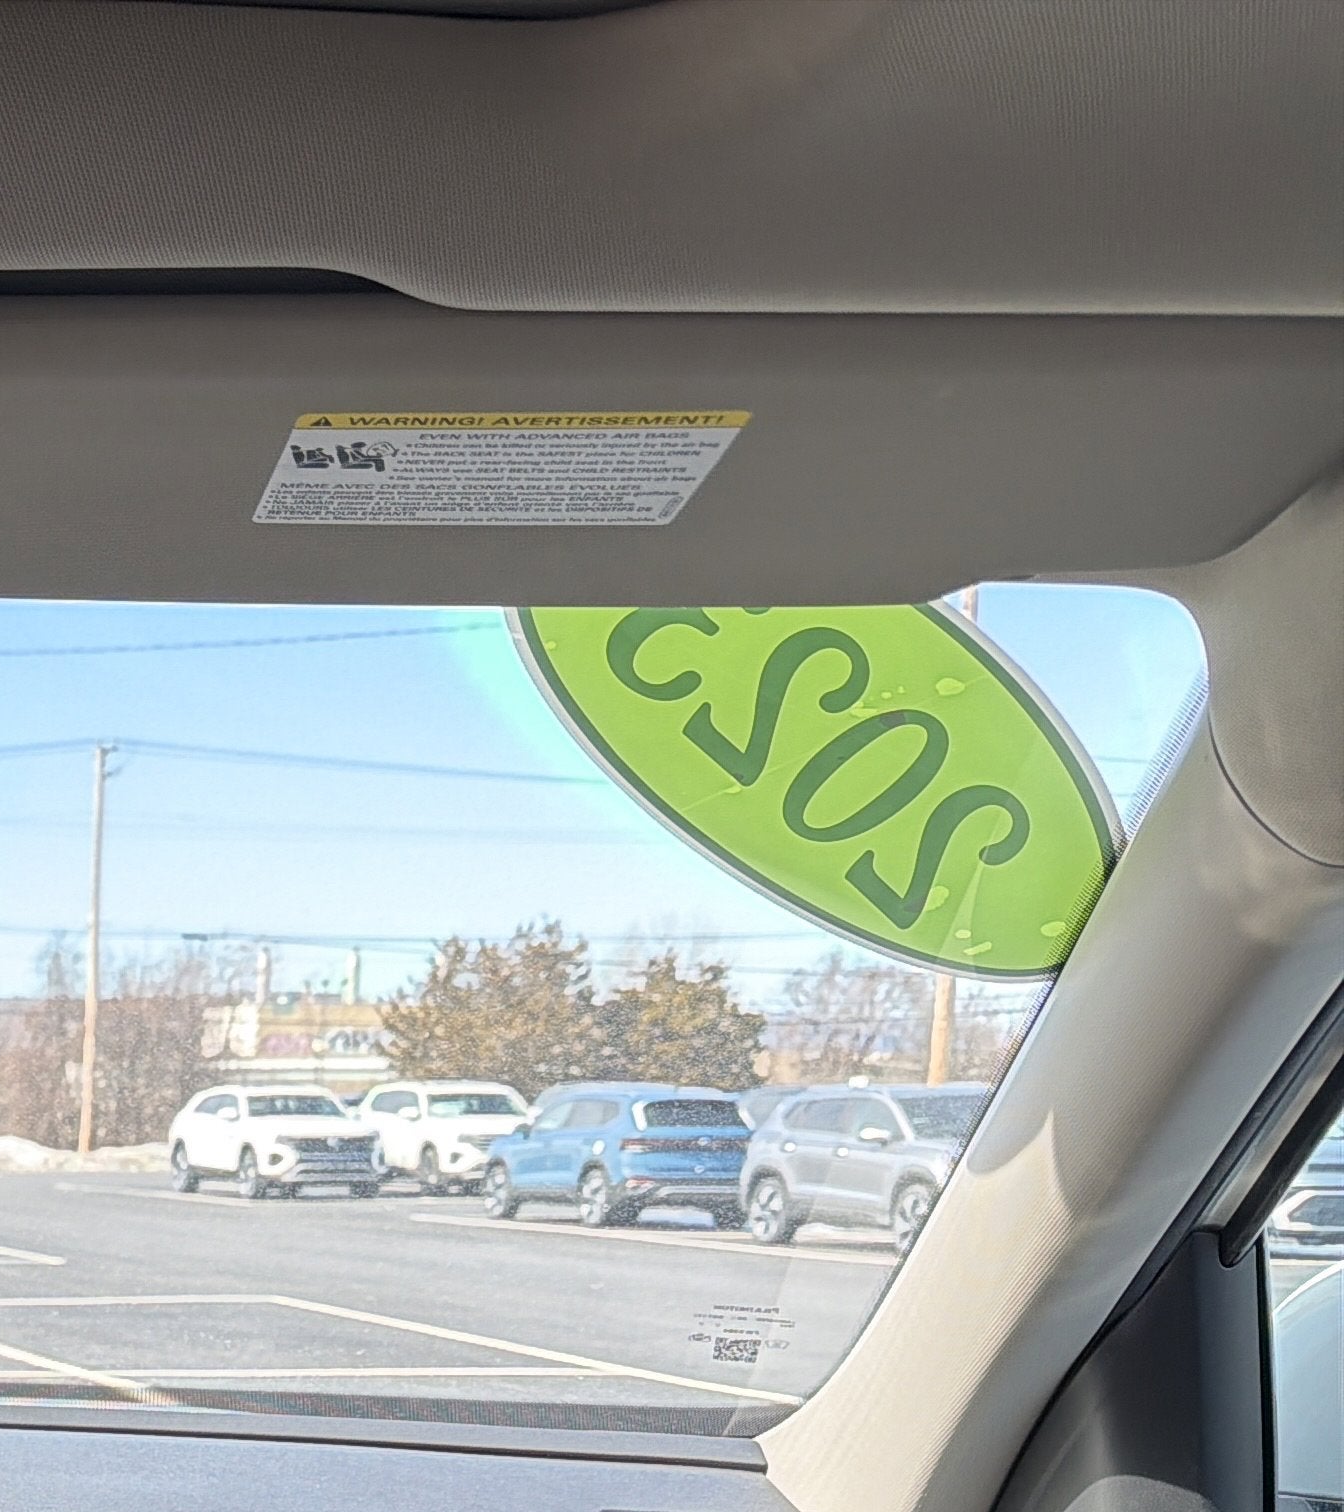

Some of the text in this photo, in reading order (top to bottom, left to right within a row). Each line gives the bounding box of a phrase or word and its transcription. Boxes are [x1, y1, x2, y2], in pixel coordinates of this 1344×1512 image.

[349, 415, 724, 426] WARNING! AVERTISSEMENT!
[419, 433, 462, 441] EVEN
[466, 433, 511, 441] WITH
[514, 432, 608, 440] ADVANCED
